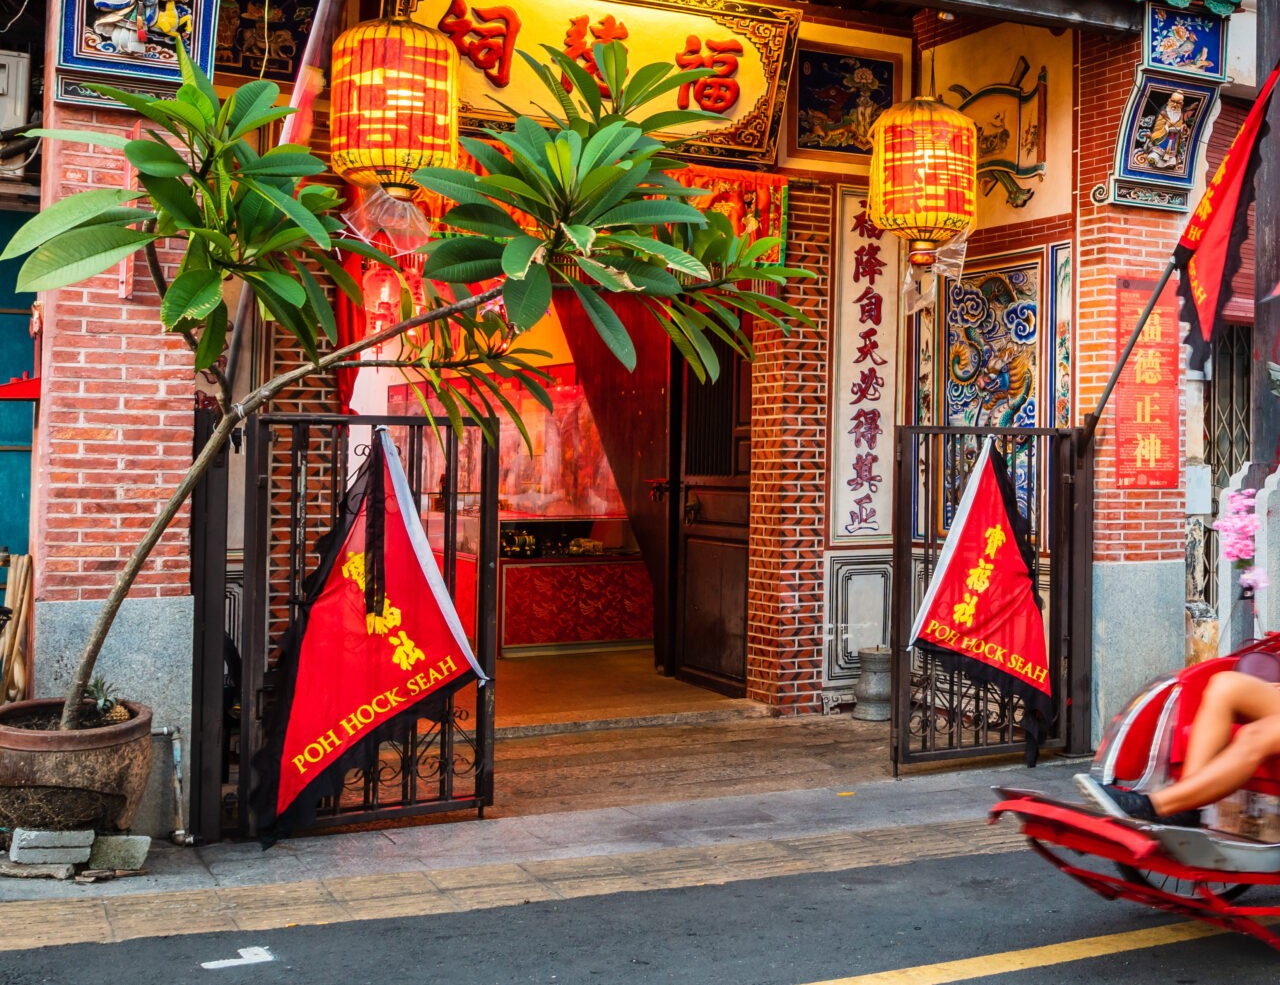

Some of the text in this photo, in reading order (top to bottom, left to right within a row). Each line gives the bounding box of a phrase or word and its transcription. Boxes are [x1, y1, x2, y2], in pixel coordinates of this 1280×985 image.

[925, 619, 1049, 685] POH HOCK SEAH
[291, 655, 458, 775] POH HOCK SEAH
